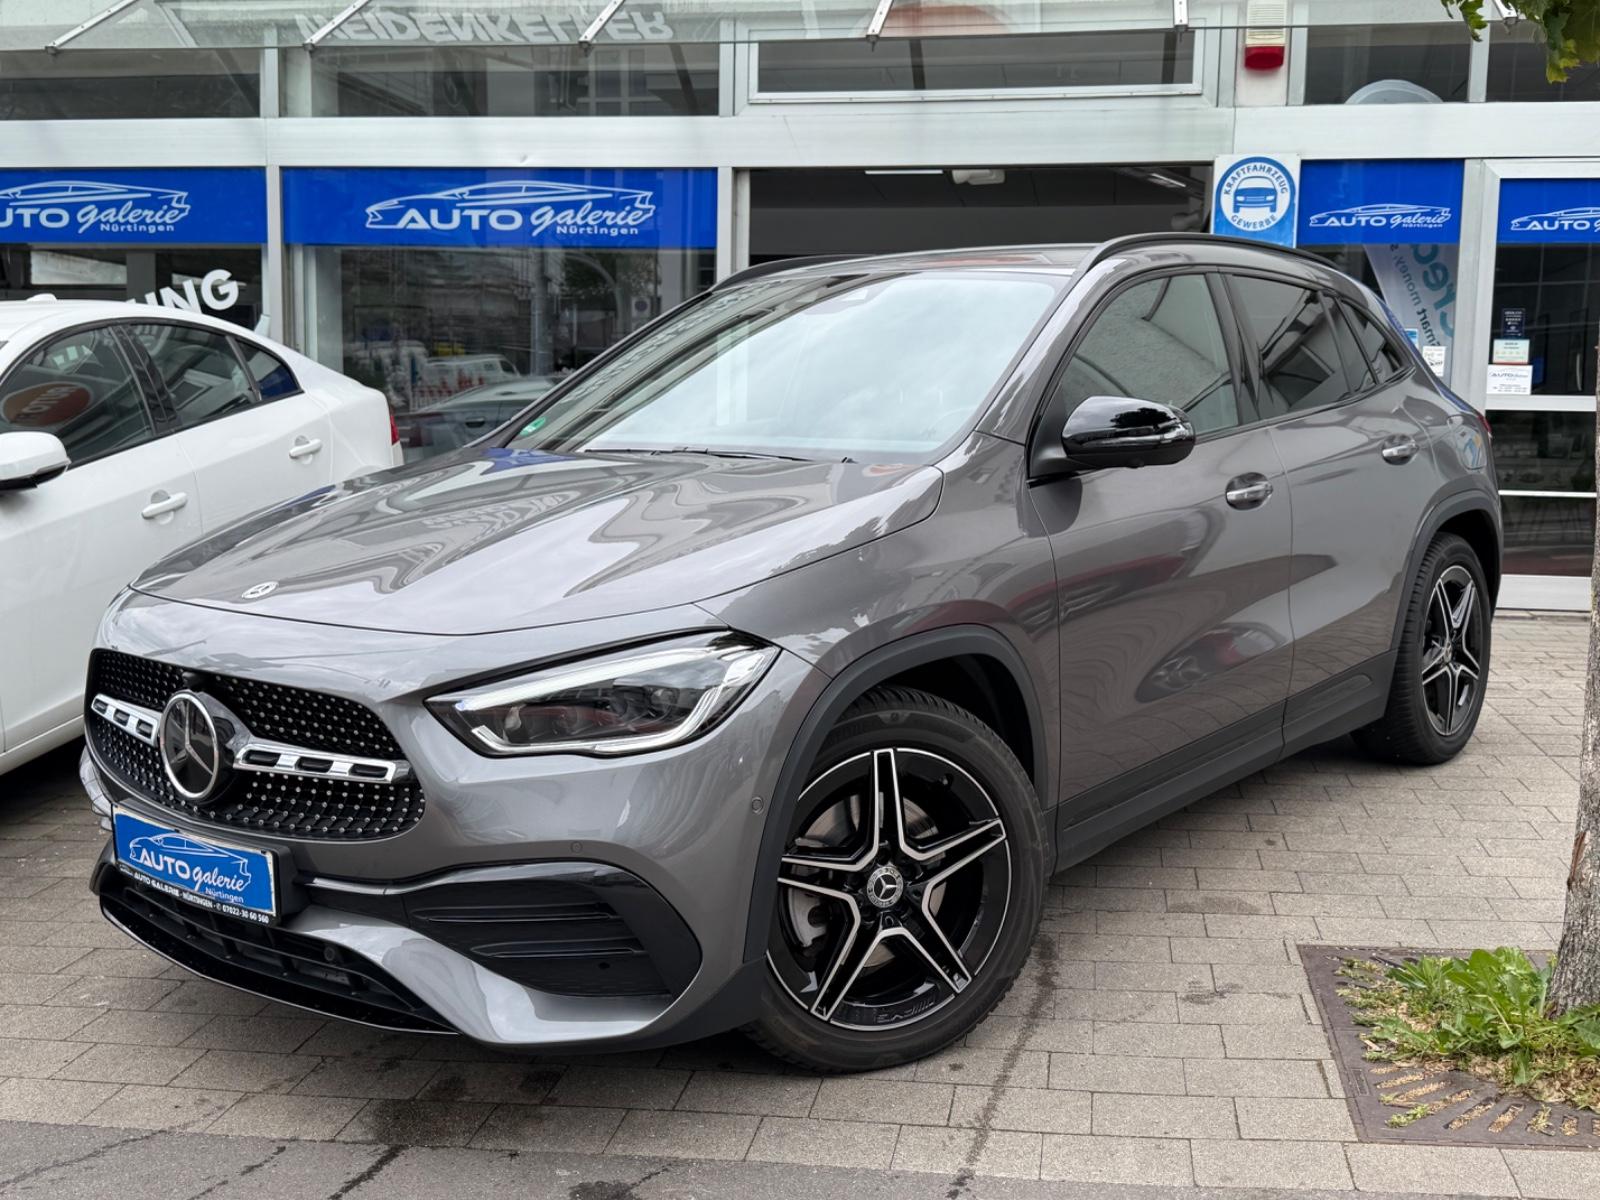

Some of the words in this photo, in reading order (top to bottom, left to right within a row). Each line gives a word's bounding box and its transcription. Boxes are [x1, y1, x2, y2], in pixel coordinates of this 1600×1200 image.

[1224, 164, 1288, 195] KRAFTFAHRZEUG
[77, 201, 184, 233] galerie
[398, 208, 523, 230] AUTO
[531, 201, 648, 236] galerie
[1231, 214, 1277, 229] GEWERBE
[1325, 216, 1386, 227] AUTO
[1390, 212, 1448, 229] galerie
[1526, 220, 1591, 230] AUTO
[100, 223, 175, 233] Nürtingen
[556, 225, 638, 236] Nürtingen
[139, 848, 191, 880] AUTO
[192, 866, 246, 892] galerie
[134, 871, 151, 885] AUTO
[151, 879, 180, 898] GALERIE
[205, 886, 244, 904] Nürtingen
